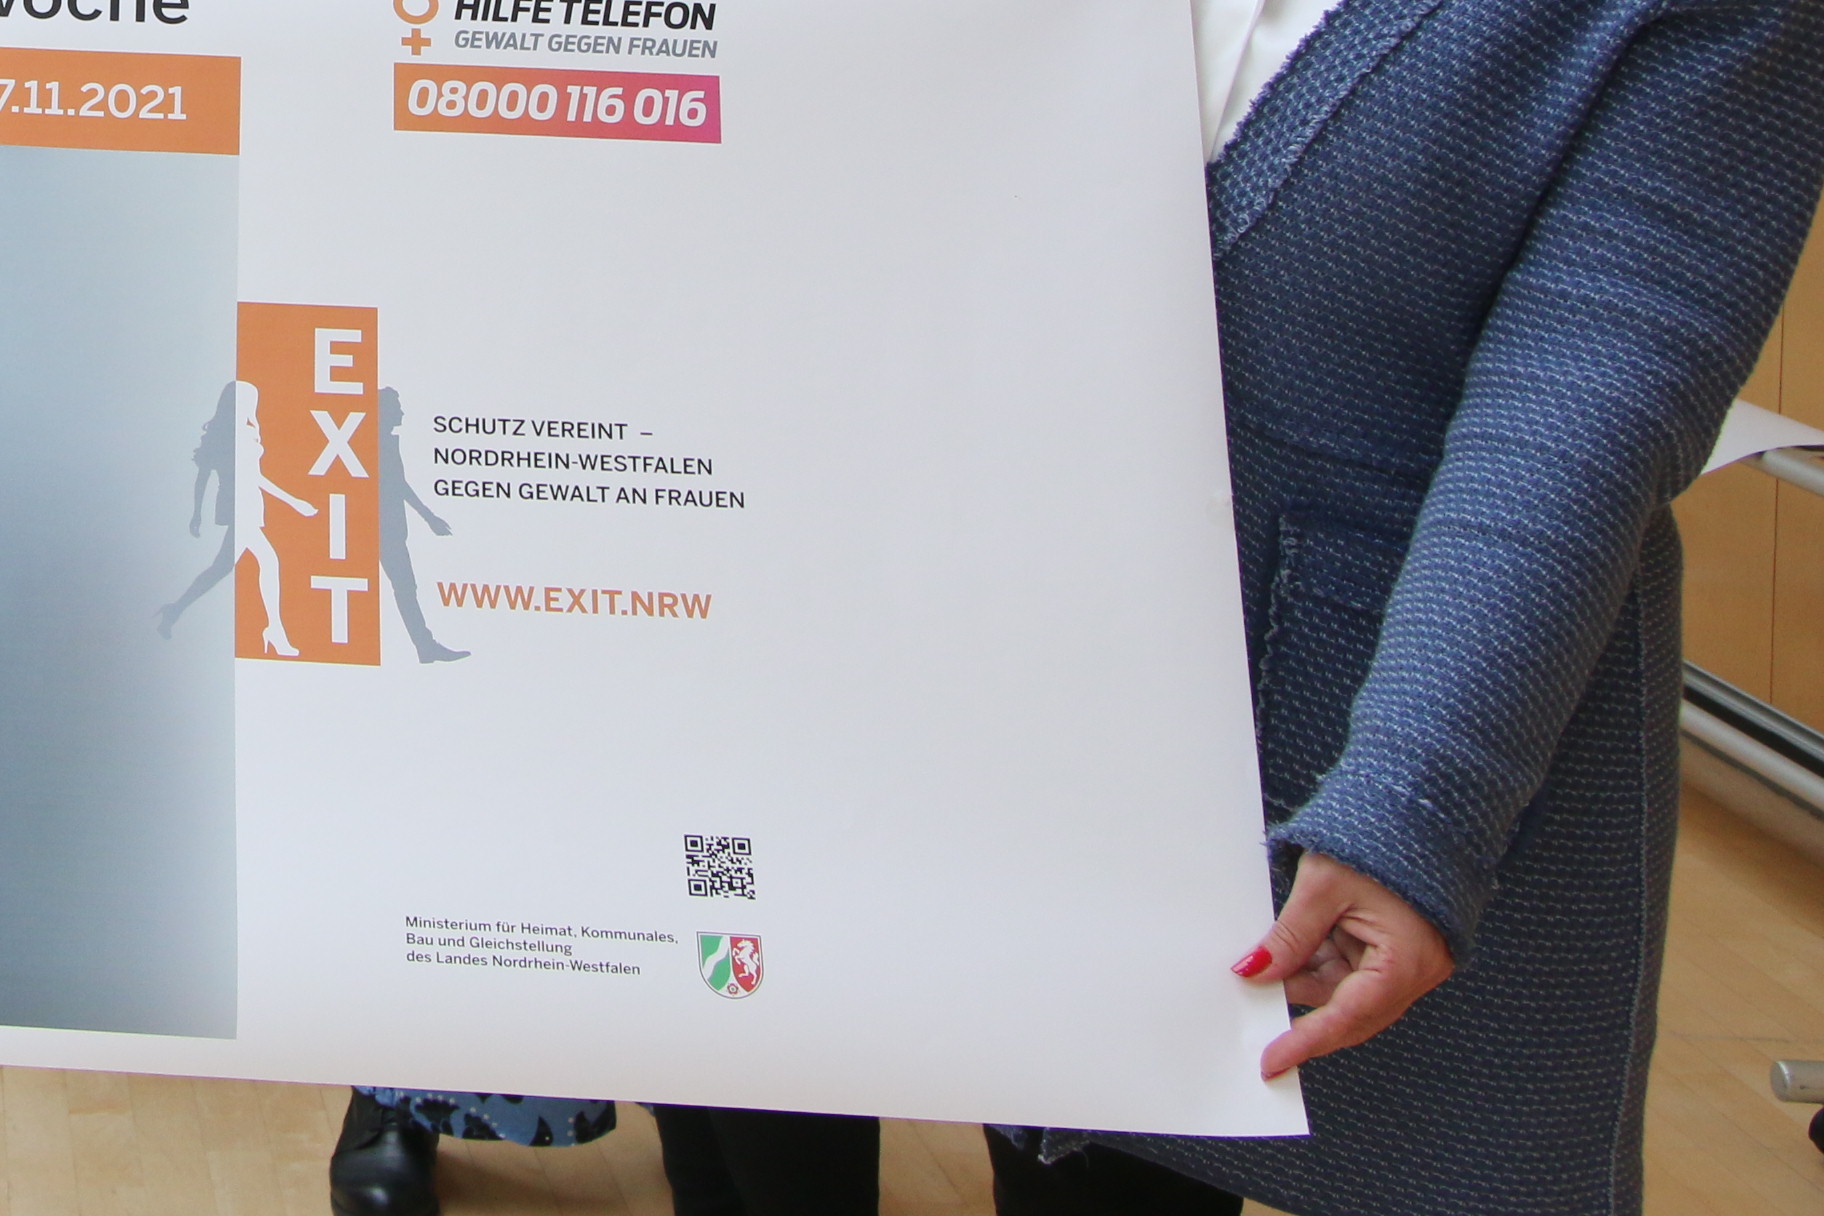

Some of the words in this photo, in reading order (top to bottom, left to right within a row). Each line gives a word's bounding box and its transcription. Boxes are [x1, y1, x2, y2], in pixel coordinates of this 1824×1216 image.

[454, 29, 546, 51] GEWALT
[547, 33, 623, 55] GEGEN
[627, 36, 719, 59] FRAUEN
[407, 78, 558, 122] 08000
[566, 85, 625, 124] 116
[633, 89, 707, 128] 016
[433, 415, 526, 437] SCHUTZ
[530, 419, 629, 441] VEREINT
[434, 447, 713, 476] NORDRHEIN-WESTFALEN
[307, 327, 370, 644] EXIT
[433, 478, 511, 499] GEGEN
[518, 482, 611, 504] GEWALT
[615, 486, 647, 505] AN
[654, 488, 745, 509] FRAUEN
[436, 581, 712, 620] WWW.EXIT.NRW
[405, 915, 492, 932] Ministerium
[495, 920, 517, 934] für
[520, 922, 578, 939] Heimat,
[580, 925, 679, 947] Kommunales,
[405, 932, 434, 946] Bau
[437, 935, 466, 948] und
[469, 936, 573, 957] Gleichstellung
[406, 949, 432, 963] des
[436, 951, 488, 967] Landes
[492, 954, 641, 976] Nordrhein-Westfalen
